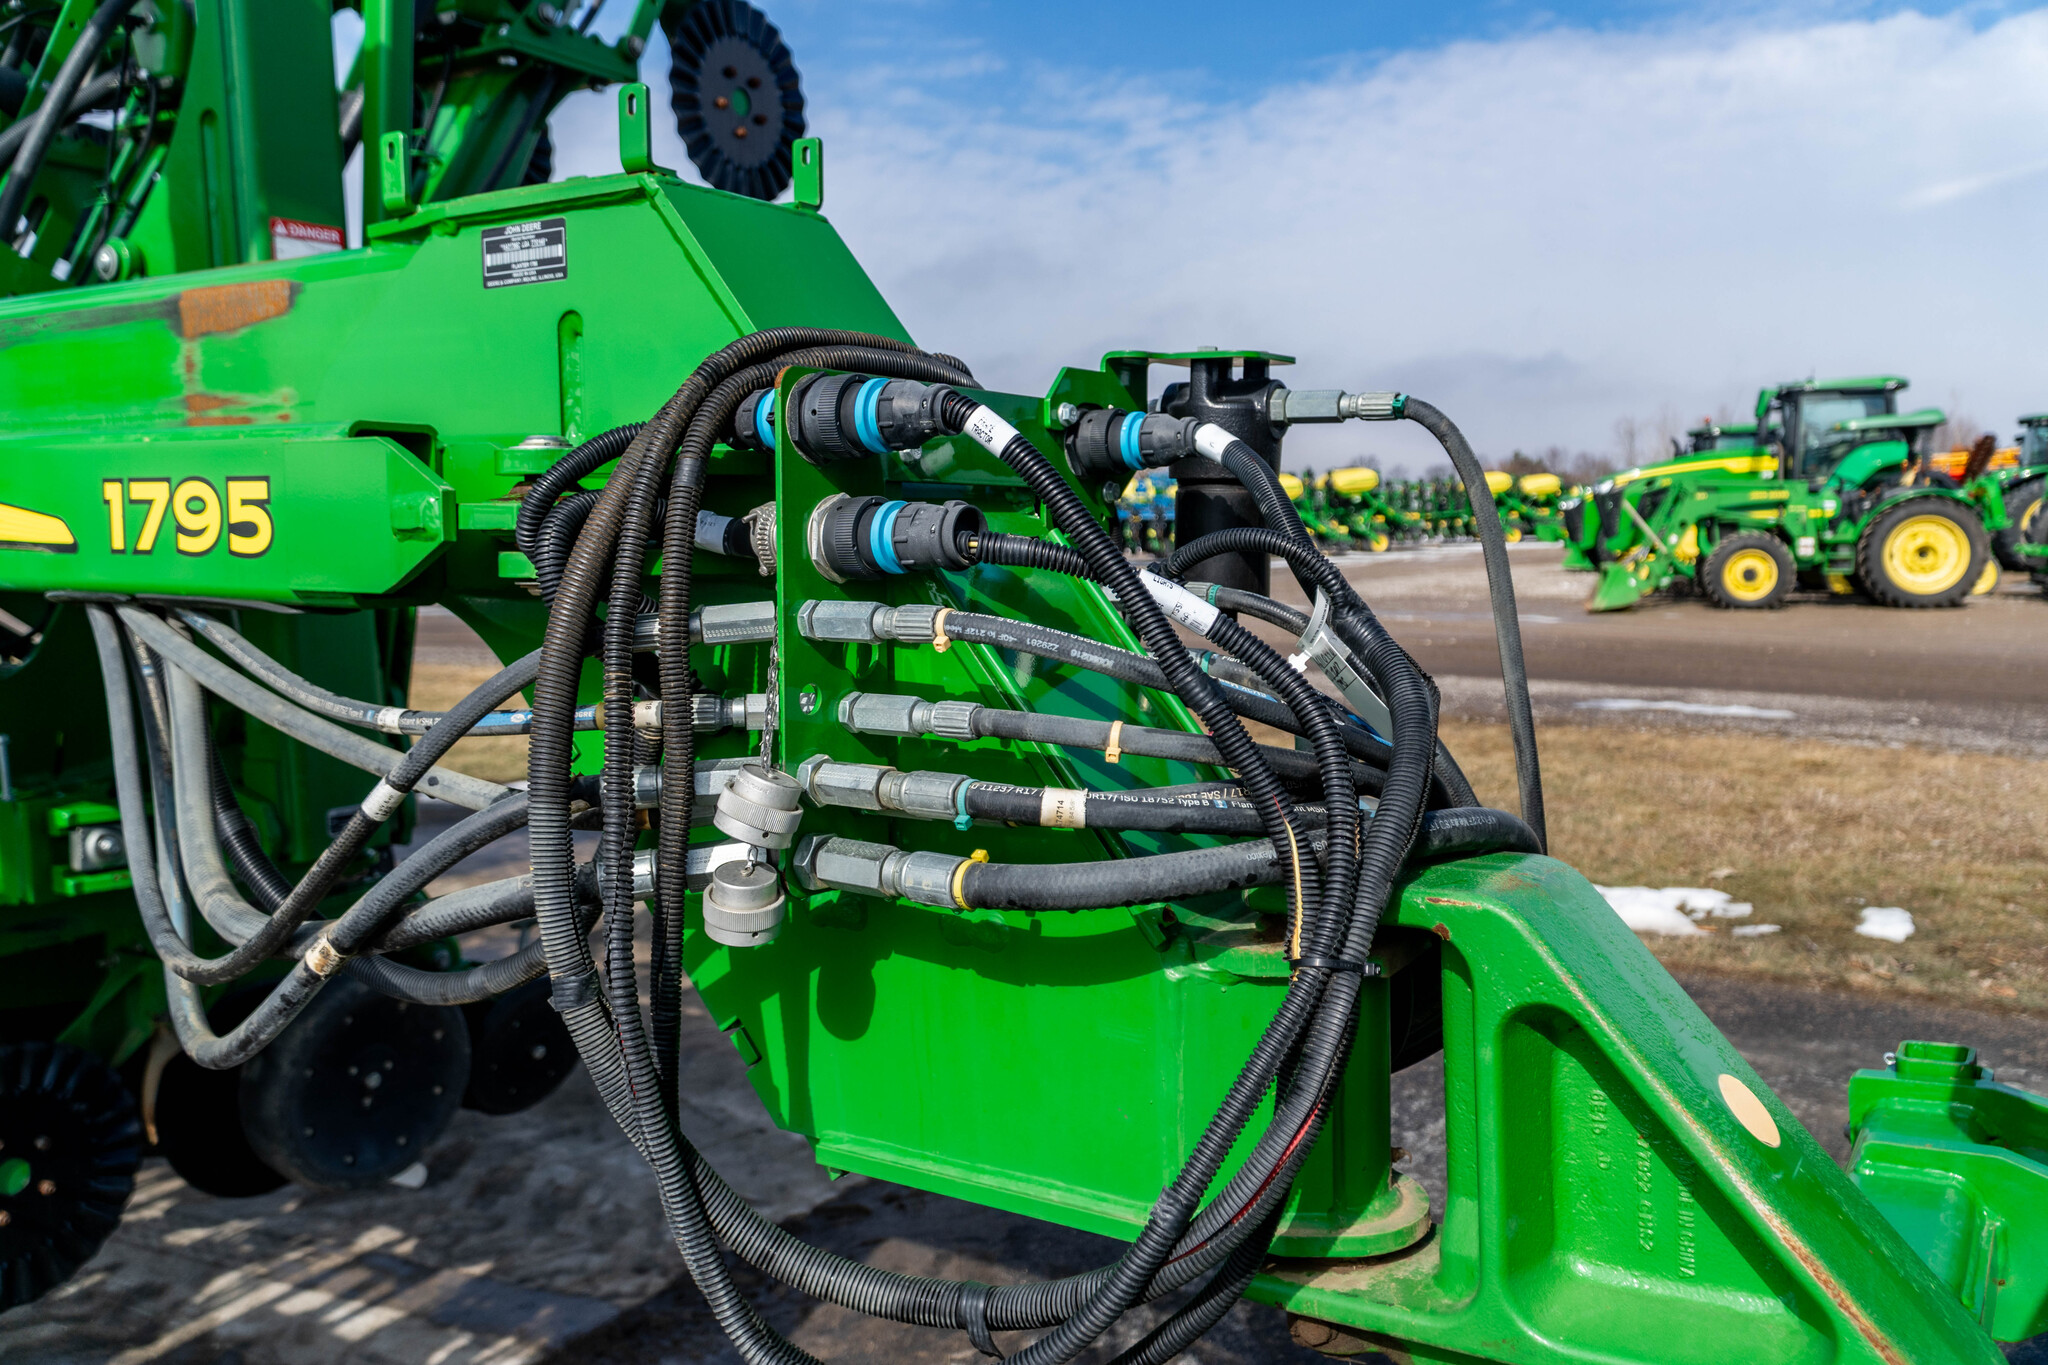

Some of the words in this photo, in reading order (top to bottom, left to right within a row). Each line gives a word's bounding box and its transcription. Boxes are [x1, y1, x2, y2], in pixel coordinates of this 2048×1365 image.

[287, 222, 340, 242] DANGER
[504, 225, 520, 235] JOHN
[521, 221, 542, 233] DEERE
[971, 423, 994, 446] TRACTOR
[102, 476, 275, 559] 1795
[1015, 787, 1037, 796] R17
[1119, 794, 1139, 803] ISO
[1177, 797, 1200, 807] Type
[1246, 850, 1277, 861] Mexico
[1678, 1231, 1696, 1279] CHINA
